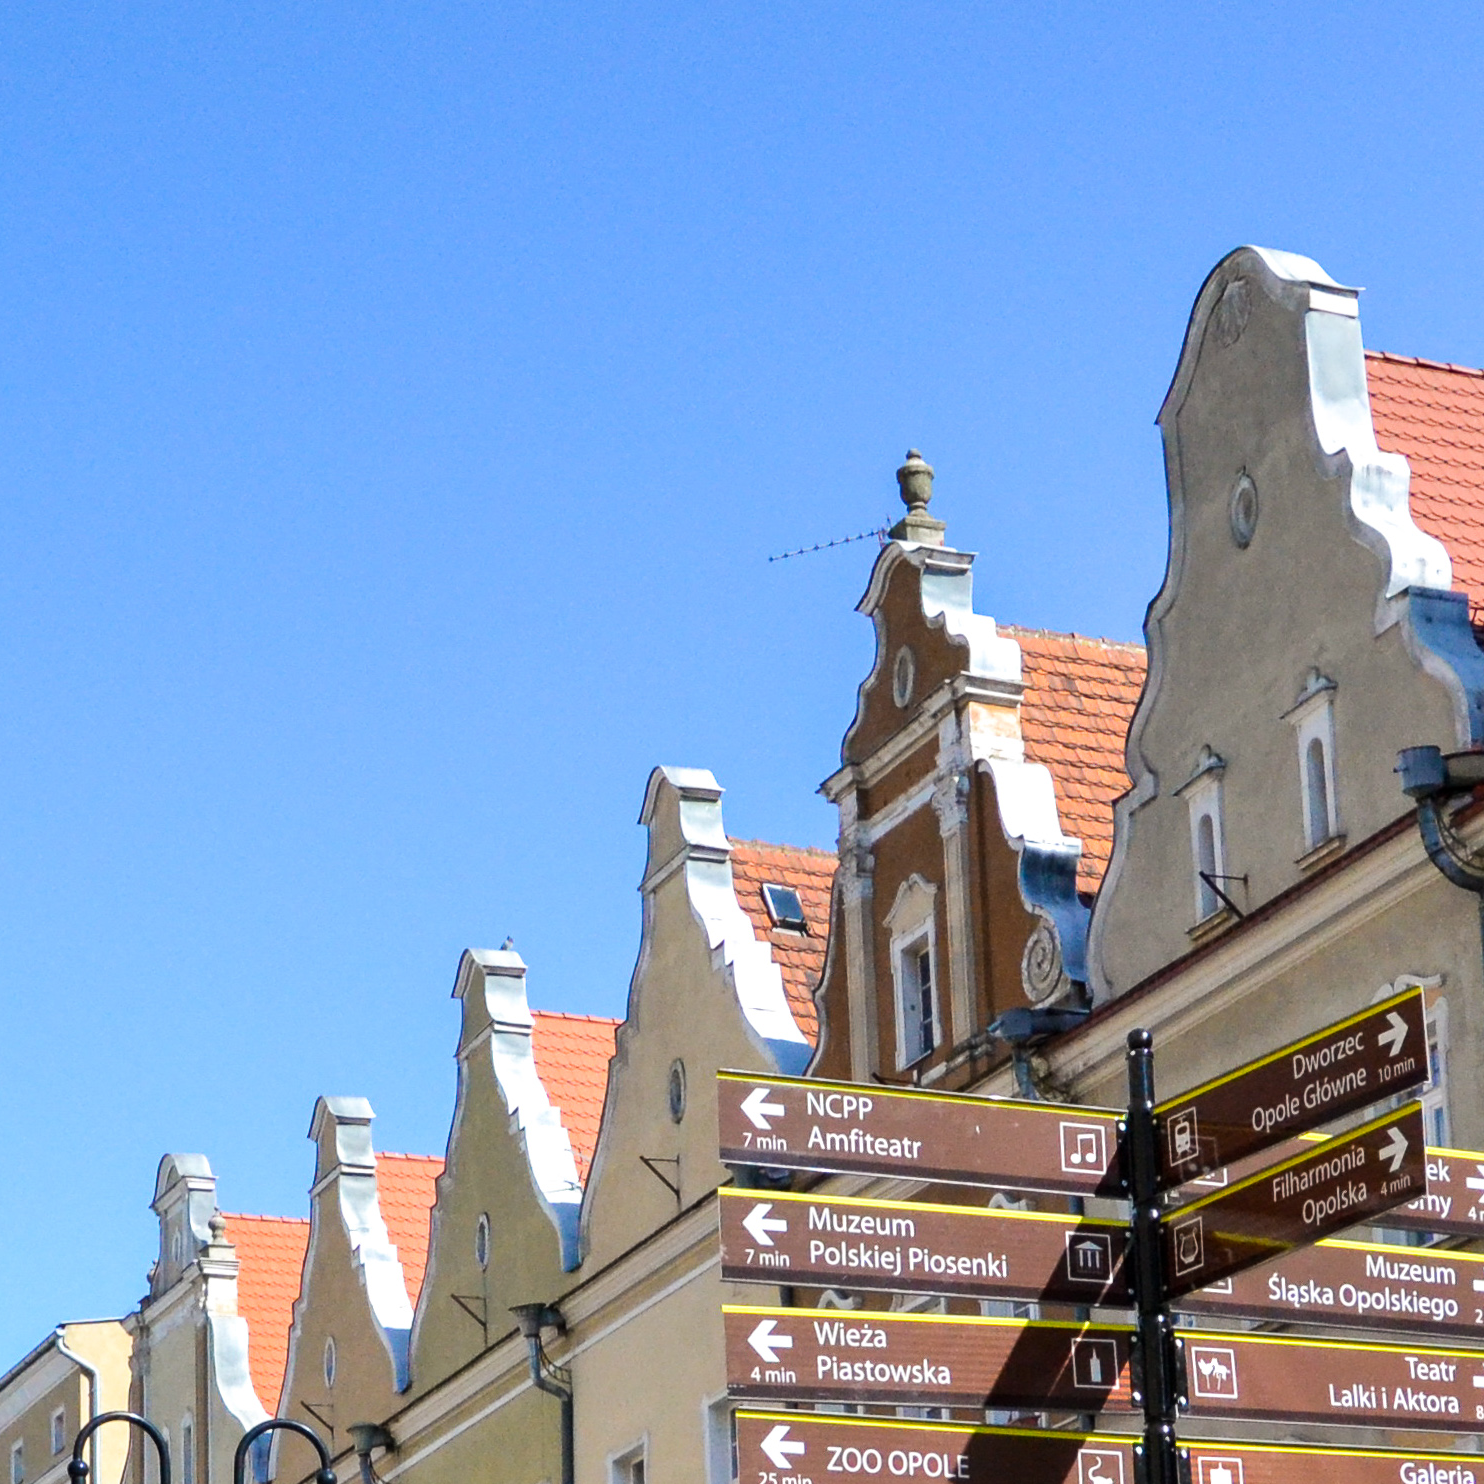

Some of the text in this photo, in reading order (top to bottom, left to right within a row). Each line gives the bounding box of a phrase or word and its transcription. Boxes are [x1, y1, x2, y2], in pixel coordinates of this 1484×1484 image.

[1292, 1031, 1365, 1080] Dworzec
[1378, 1056, 1416, 1083] 10 min
[806, 1091, 873, 1121] NCPP
[1251, 1067, 1367, 1133] Opole Główne
[742, 1132, 787, 1151] 7 min
[807, 1125, 922, 1159] Amfiteatr
[1272, 1144, 1366, 1203] Filharmonia
[1380, 1173, 1411, 1196] 4 min
[1302, 1180, 1367, 1226] Opolska
[1467, 1206, 1477, 1221] 4
[808, 1206, 915, 1238] Muzeum
[745, 1248, 790, 1267] 7 min
[809, 1239, 1008, 1278] Polskiej Piosenki
[1365, 1254, 1456, 1285] Muzeum
[1267, 1272, 1459, 1321] Śląska Opolskiego
[1474, 1308, 1484, 1324] 2
[813, 1320, 887, 1348] Wieża
[750, 1366, 796, 1384] 4 min
[816, 1355, 951, 1385] Piastowska
[1404, 1356, 1457, 1382] Teatr
[1328, 1383, 1460, 1414] Lalki i Aktora
[1475, 1404, 1484, 1420] 8
[826, 1446, 971, 1479] ZOO OPOLE
